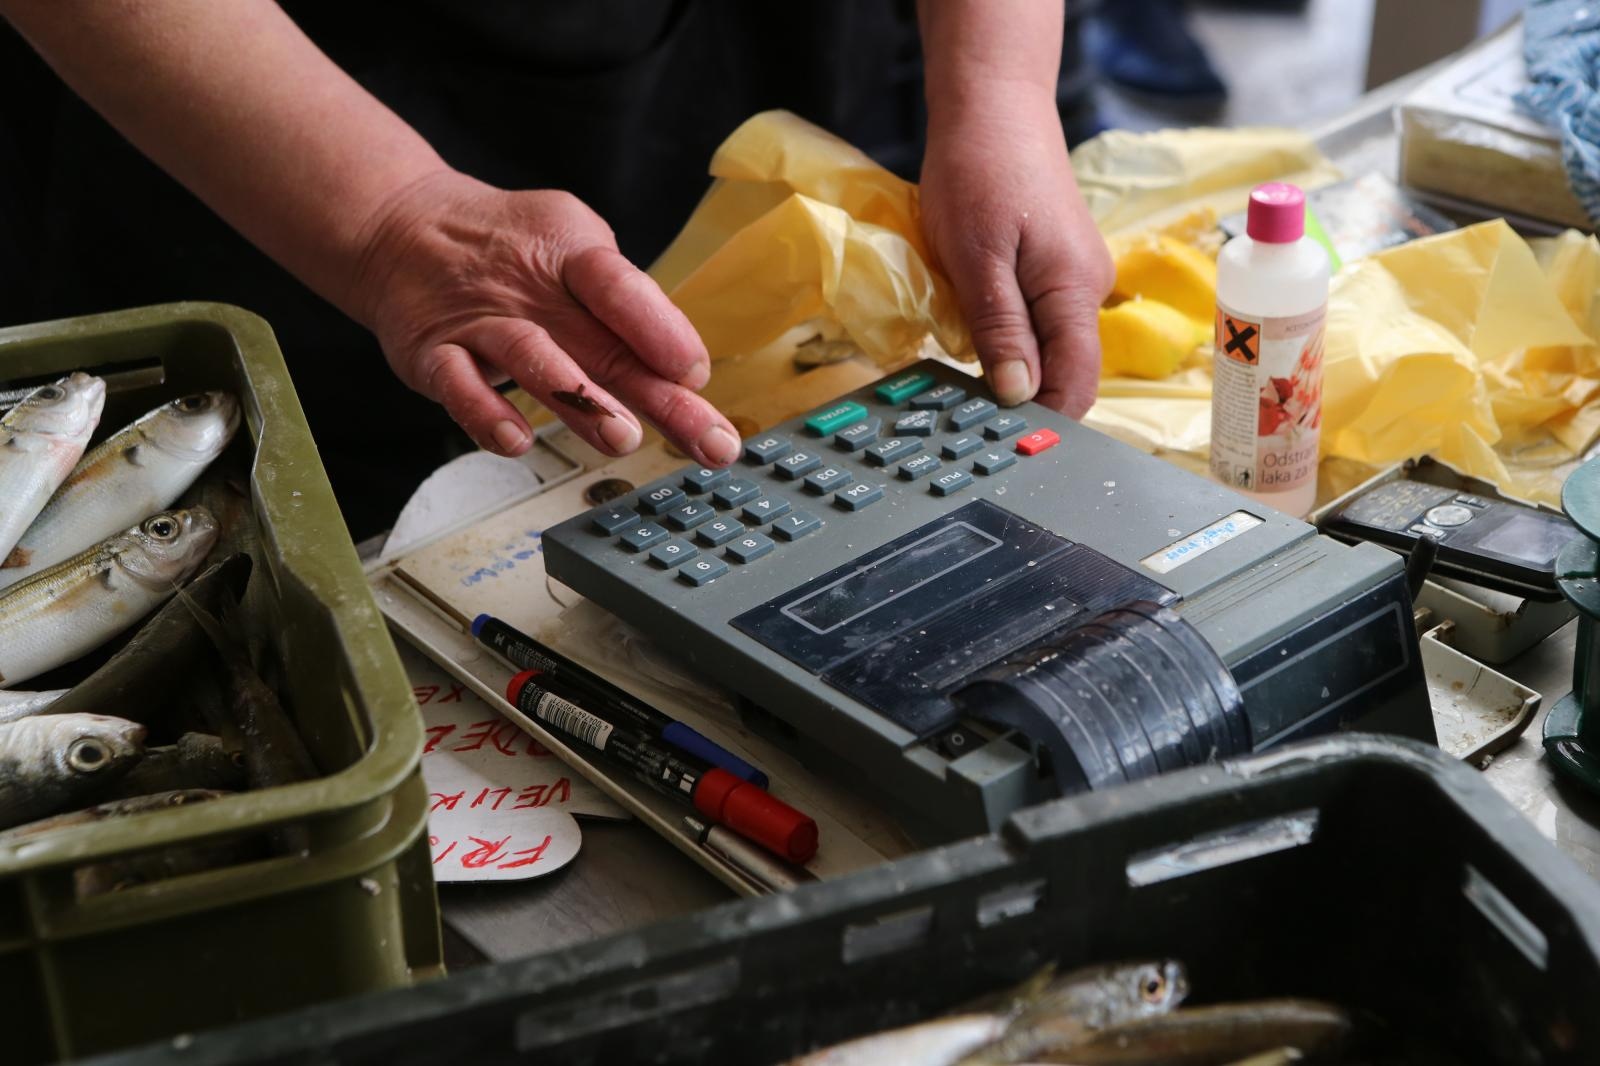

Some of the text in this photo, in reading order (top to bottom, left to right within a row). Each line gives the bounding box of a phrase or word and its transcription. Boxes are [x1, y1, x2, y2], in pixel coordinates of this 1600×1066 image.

[962, 401, 985, 414] PY1
[817, 406, 852, 422] TOTAL
[844, 425, 869, 437] STL
[757, 438, 779, 450] D1
[1031, 434, 1043, 442] C
[878, 440, 901, 454] QTY
[785, 453, 809, 466] D2
[907, 455, 930, 469] PRC
[699, 469, 713, 477] 0
[816, 468, 839, 482] D3
[939, 471, 962, 484] PLU
[1261, 466, 1308, 485] laka za
[650, 488, 673, 501] 00
[729, 485, 742, 493] 1
[847, 484, 870, 497] D4
[681, 505, 698, 516] 2
[758, 500, 770, 509] 4
[712, 523, 727, 532] 5
[791, 517, 805, 526] 7
[637, 528, 652, 537] 3
[666, 545, 680, 554] 6
[742, 539, 757, 548] 8
[696, 561, 711, 570] 9
